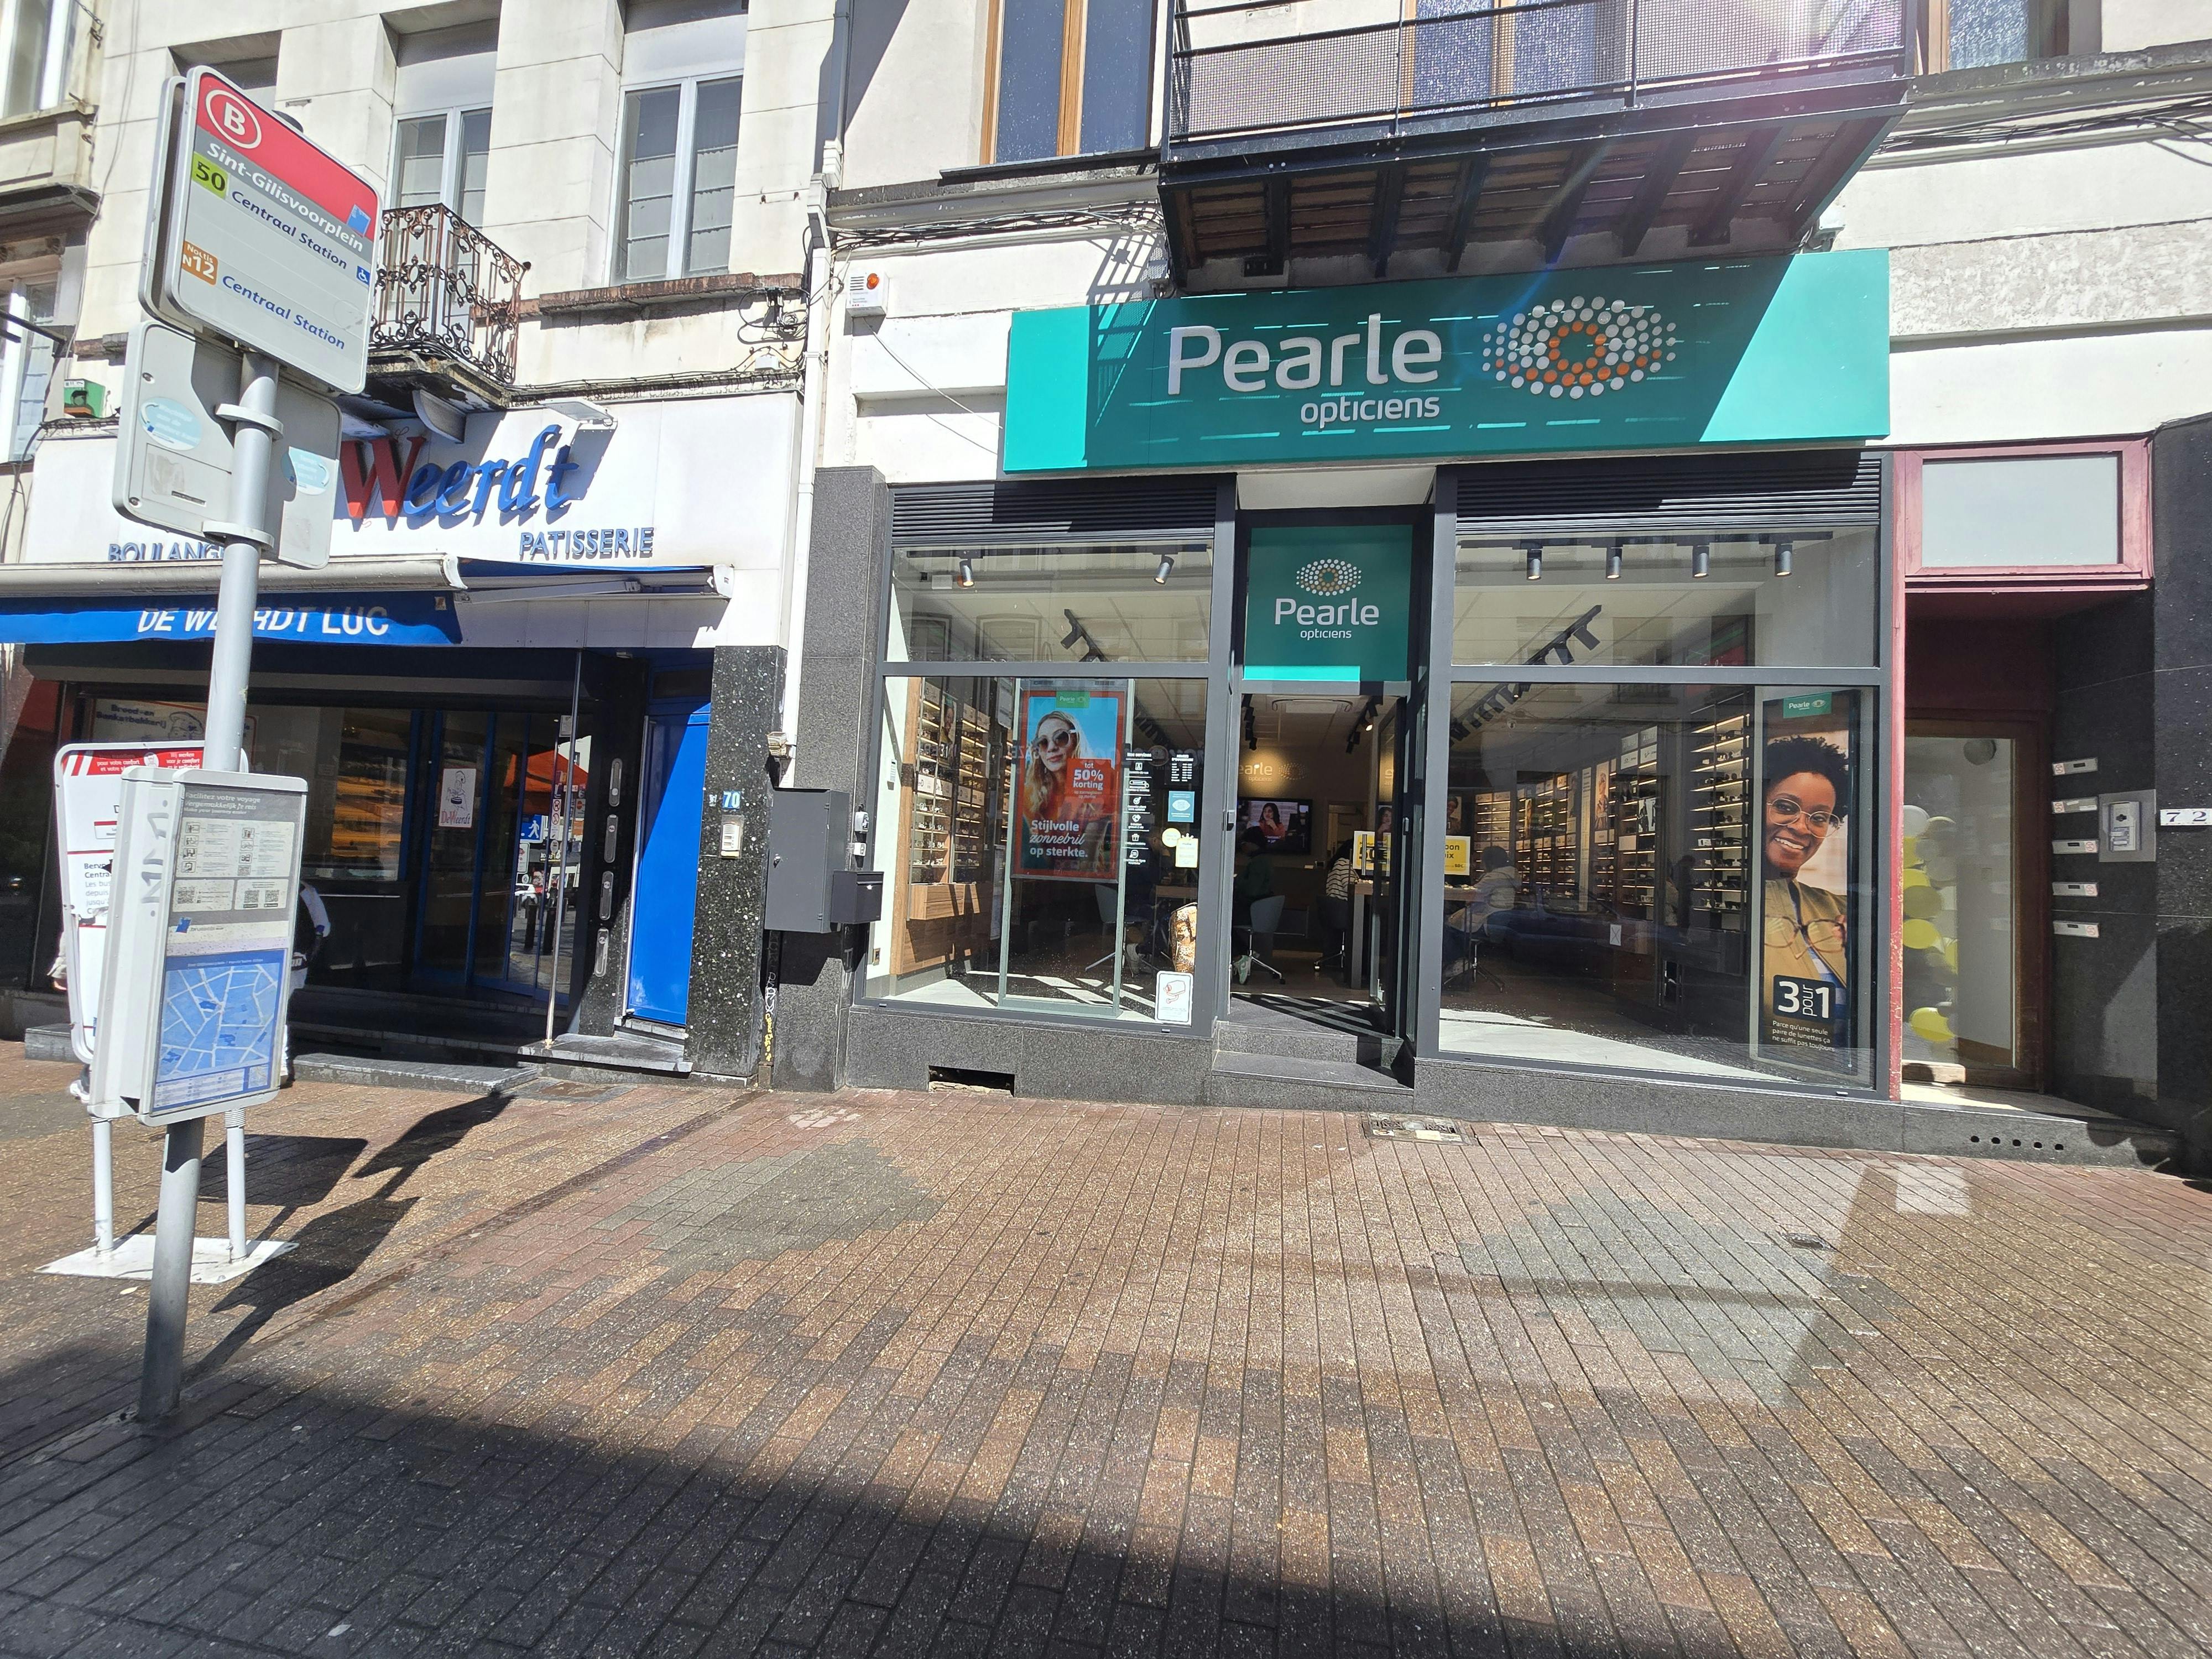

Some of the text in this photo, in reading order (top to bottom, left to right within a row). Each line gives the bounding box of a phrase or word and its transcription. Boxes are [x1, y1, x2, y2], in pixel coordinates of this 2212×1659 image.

[224, 102, 246, 135] B
[195, 162, 226, 191] 50
[206, 142, 363, 253] Sint-Gilisvoorplein
[231, 190, 347, 270] Centraal Station
[182, 253, 215, 280] N12
[222, 275, 346, 351] Centraal Station
[1168, 313, 1442, 395] Pearle
[1301, 397, 1439, 429] opticiens
[340, 424, 579, 519] Weerdt
[108, 542, 225, 561] BOULANG
[520, 527, 654, 556] PATISSERIE
[138, 608, 180, 633] DE
[322, 606, 389, 636] LUC
[1275, 598, 1379, 625] Pearle
[1300, 628, 1352, 640] opticiens
[1073, 780, 1103, 791] korting
[1074, 769, 1104, 781] 50%
[723, 791, 740, 808] 70
[1029, 832, 1086, 845] zonnebril
[1031, 820, 1079, 833] Stijlvolle
[1030, 846, 1088, 858] op sterkte.
[86, 899, 109, 907] jusqu'
[1778, 980, 1829, 1019] 3 pour 1
[1790, 1024, 1811, 1032] qu'une
[1797, 1032, 1822, 1042] lunettes
[1809, 1042, 1835, 1052] toujours
